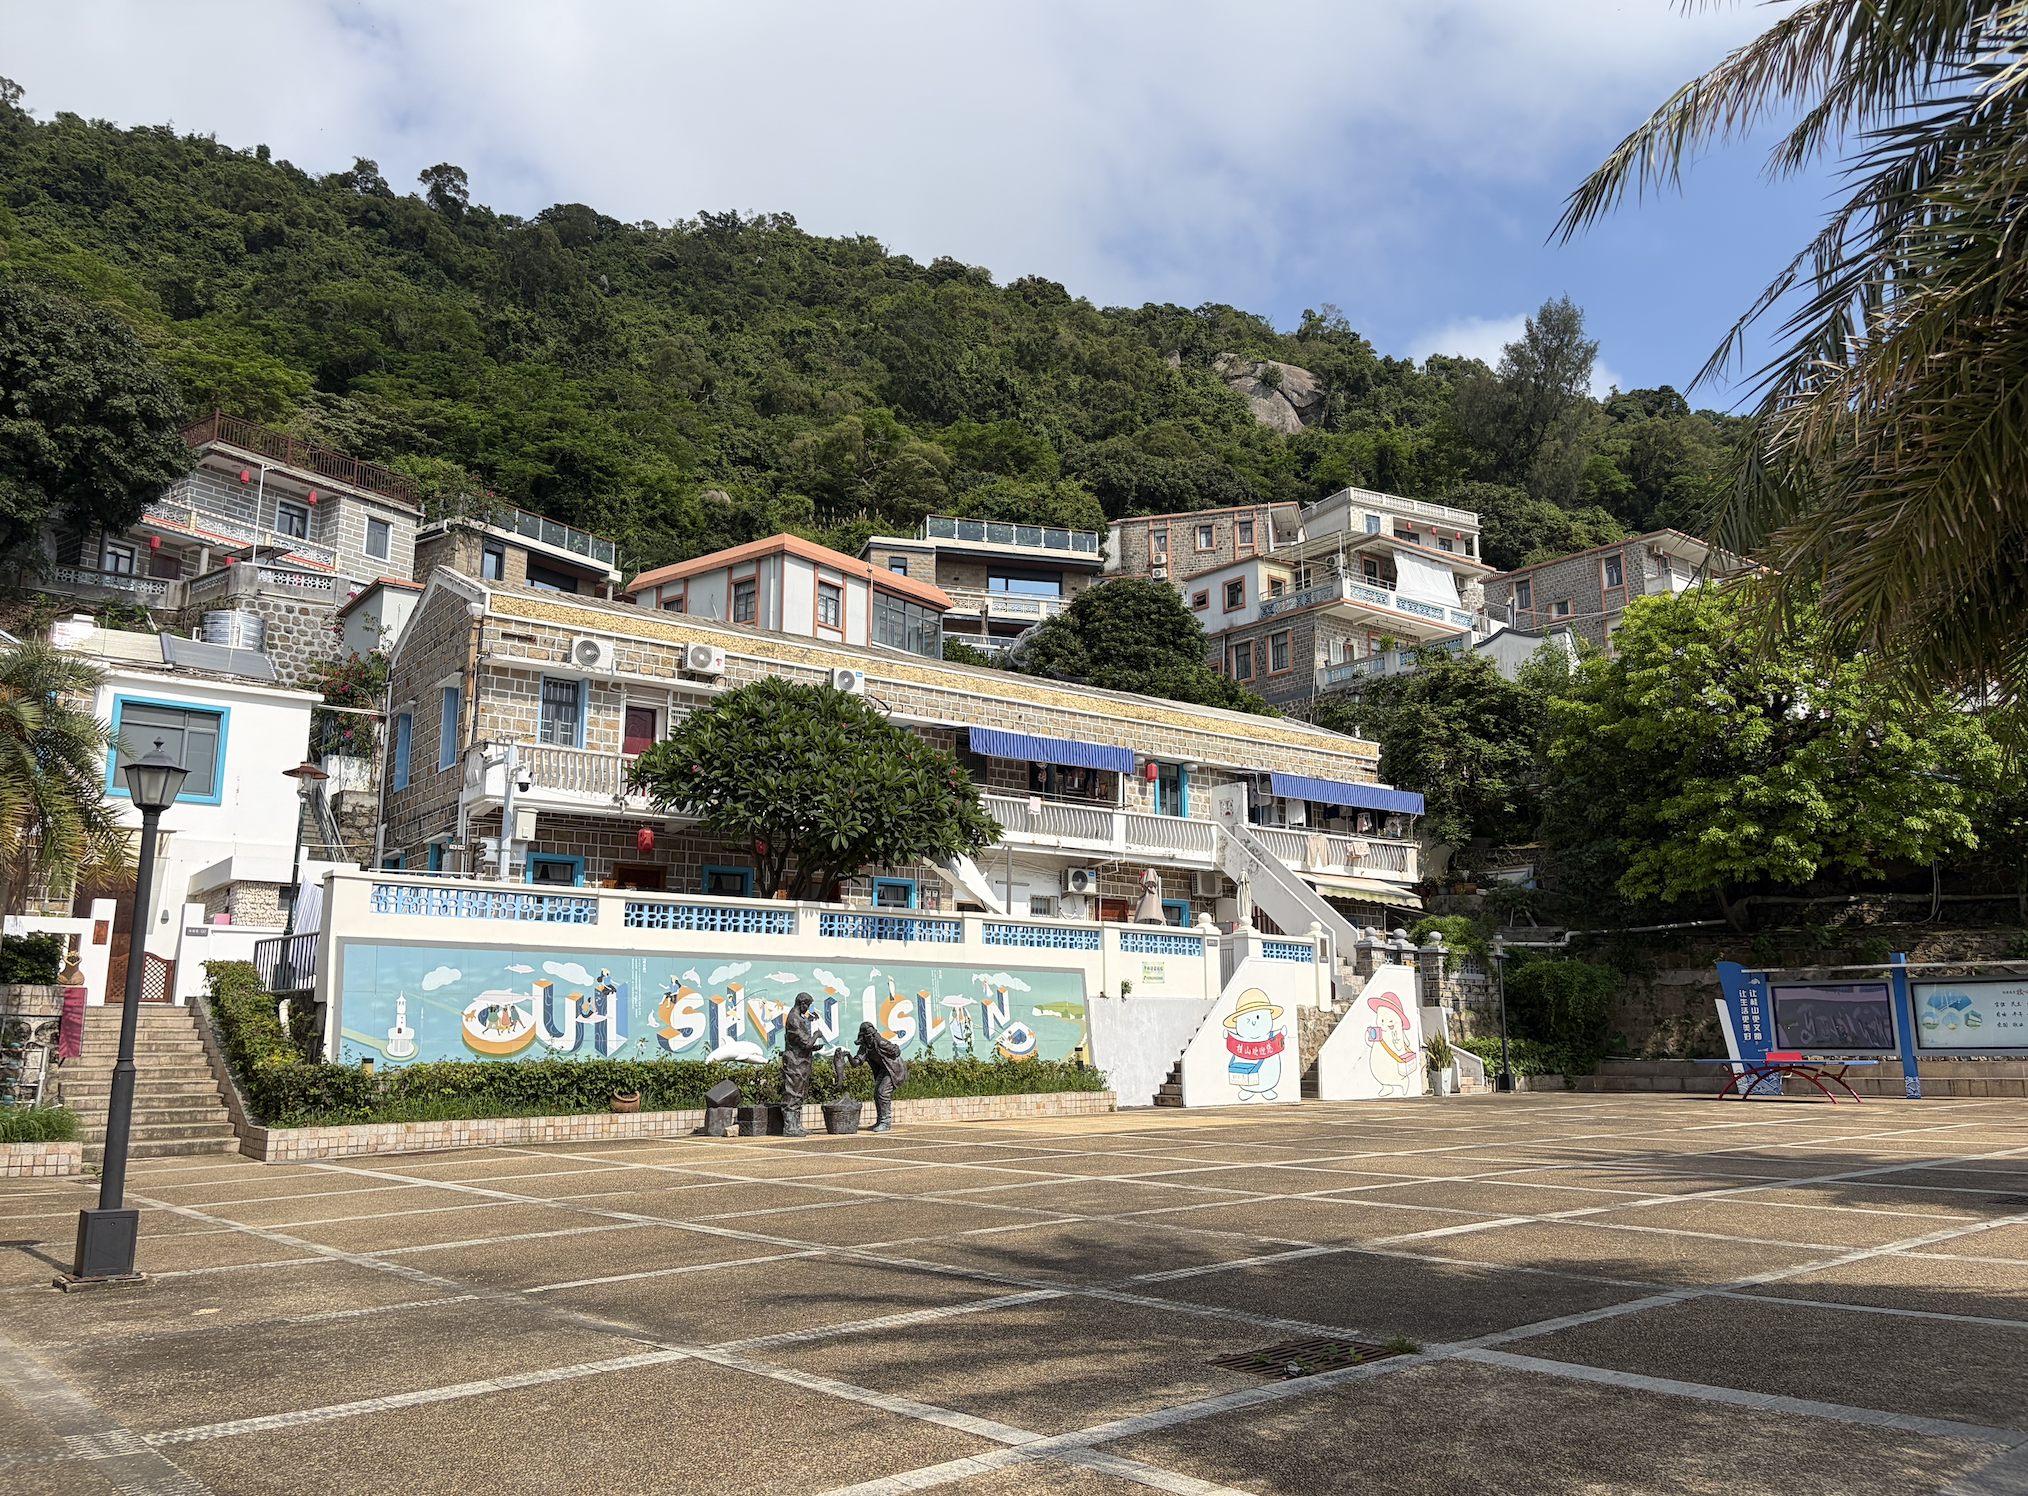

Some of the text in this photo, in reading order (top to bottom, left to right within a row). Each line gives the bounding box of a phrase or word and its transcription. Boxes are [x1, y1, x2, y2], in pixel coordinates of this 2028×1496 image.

[1738, 989, 1751, 1040] 让生活更美好
[1236, 1043, 1274, 1057] 桂山欢迎您
